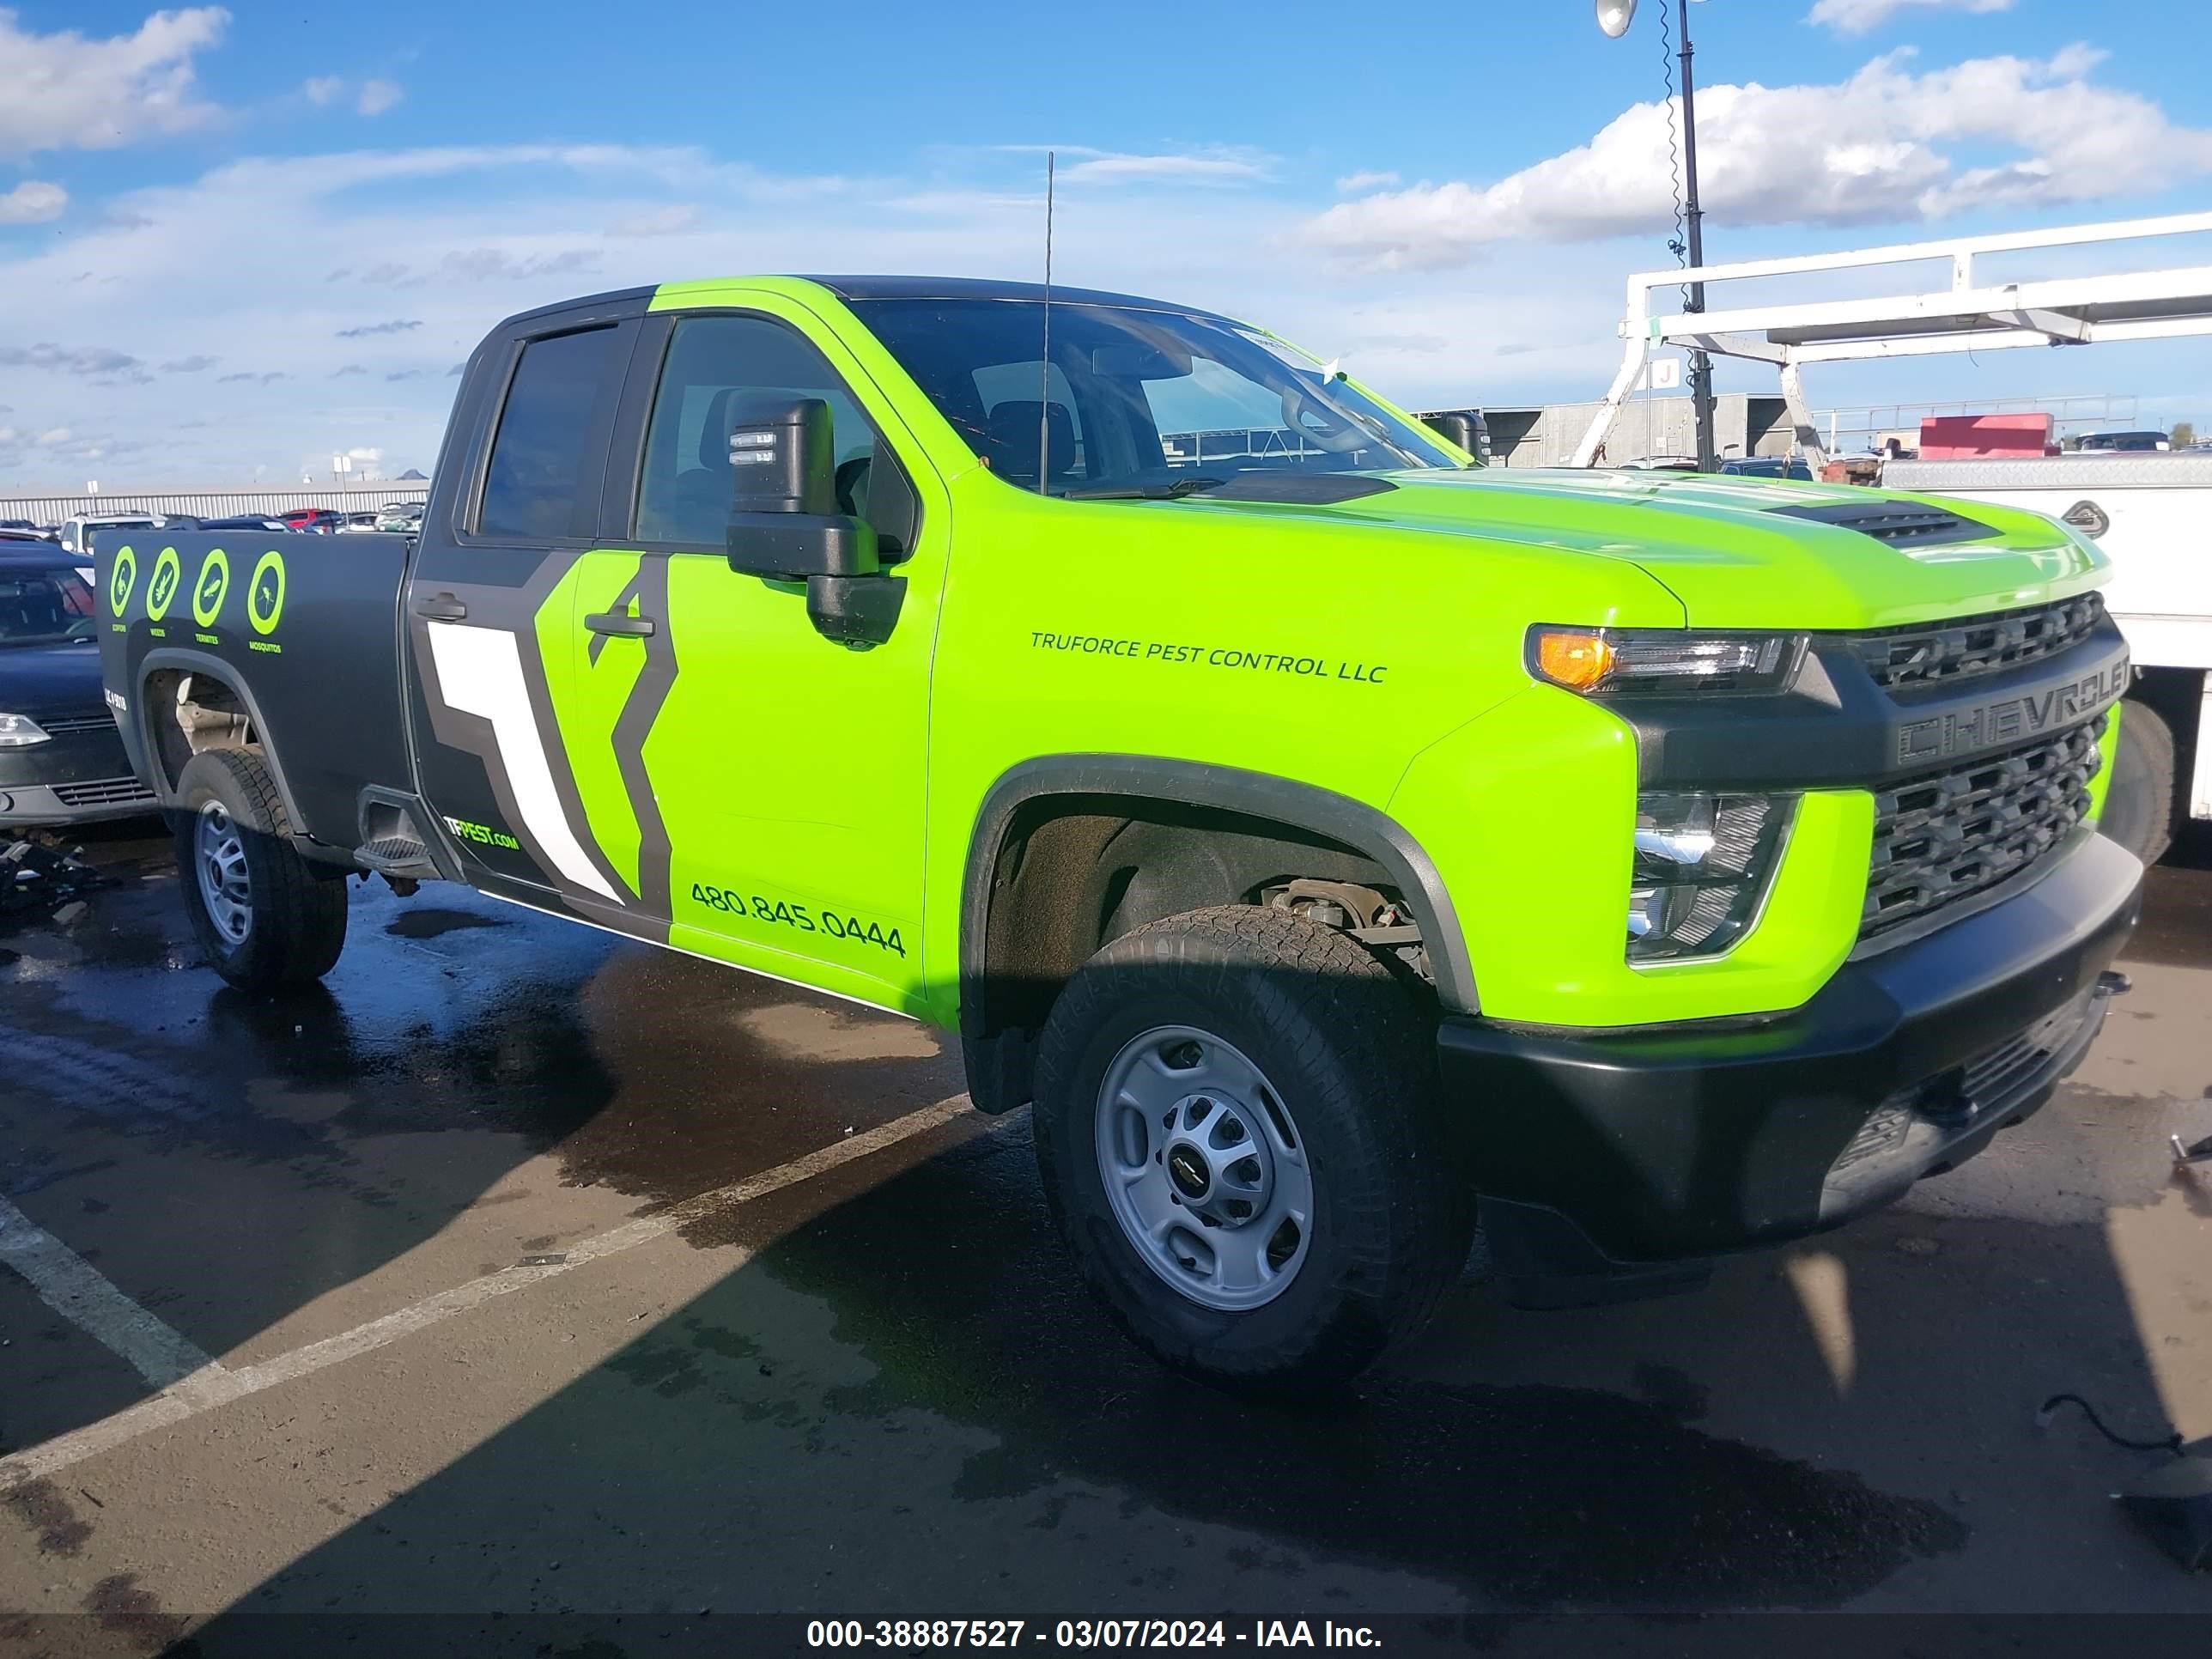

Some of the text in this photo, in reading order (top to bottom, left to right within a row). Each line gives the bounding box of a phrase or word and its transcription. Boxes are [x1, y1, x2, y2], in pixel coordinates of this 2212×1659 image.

[1660, 364, 1671, 383] J
[194, 633, 219, 645] TERMITES
[248, 641, 282, 653] MOSQUITOS
[1030, 631, 1389, 684] TRUFORCE PEST CONTROL LLC
[1898, 655, 2130, 764] CHEVROLET
[442, 815, 520, 850] TFPEST.COM
[691, 883, 907, 959] 480.845.0444
